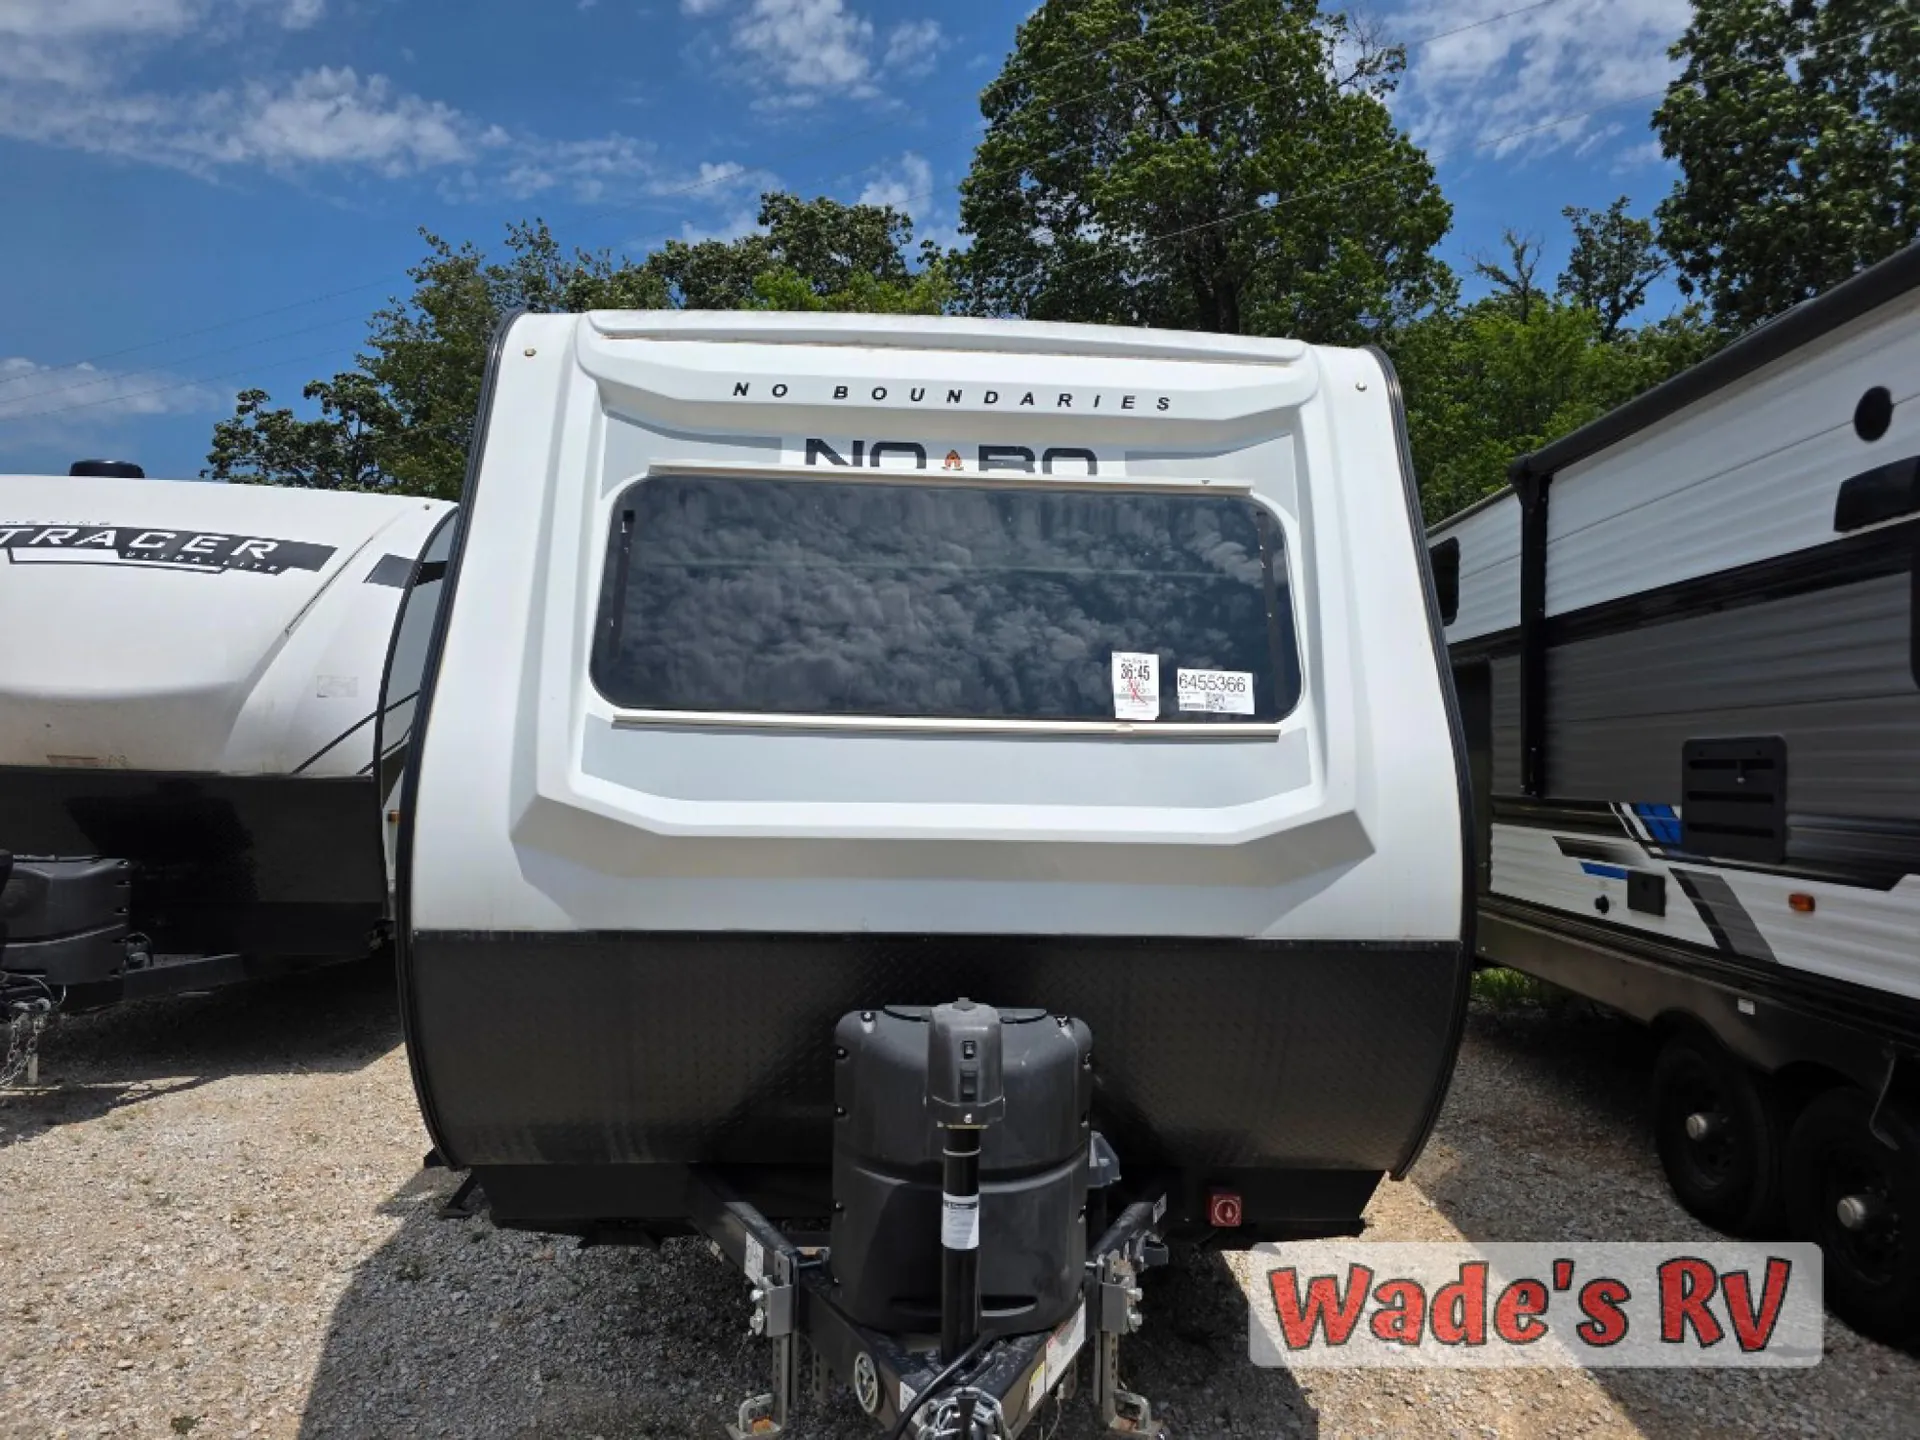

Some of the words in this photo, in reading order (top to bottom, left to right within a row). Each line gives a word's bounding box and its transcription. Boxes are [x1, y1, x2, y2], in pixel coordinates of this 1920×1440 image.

[733, 382, 788, 398] NO
[833, 385, 1170, 412] BOUNDARIES
[0, 528, 279, 560] TRACER
[1179, 673, 1246, 692] 6455366
